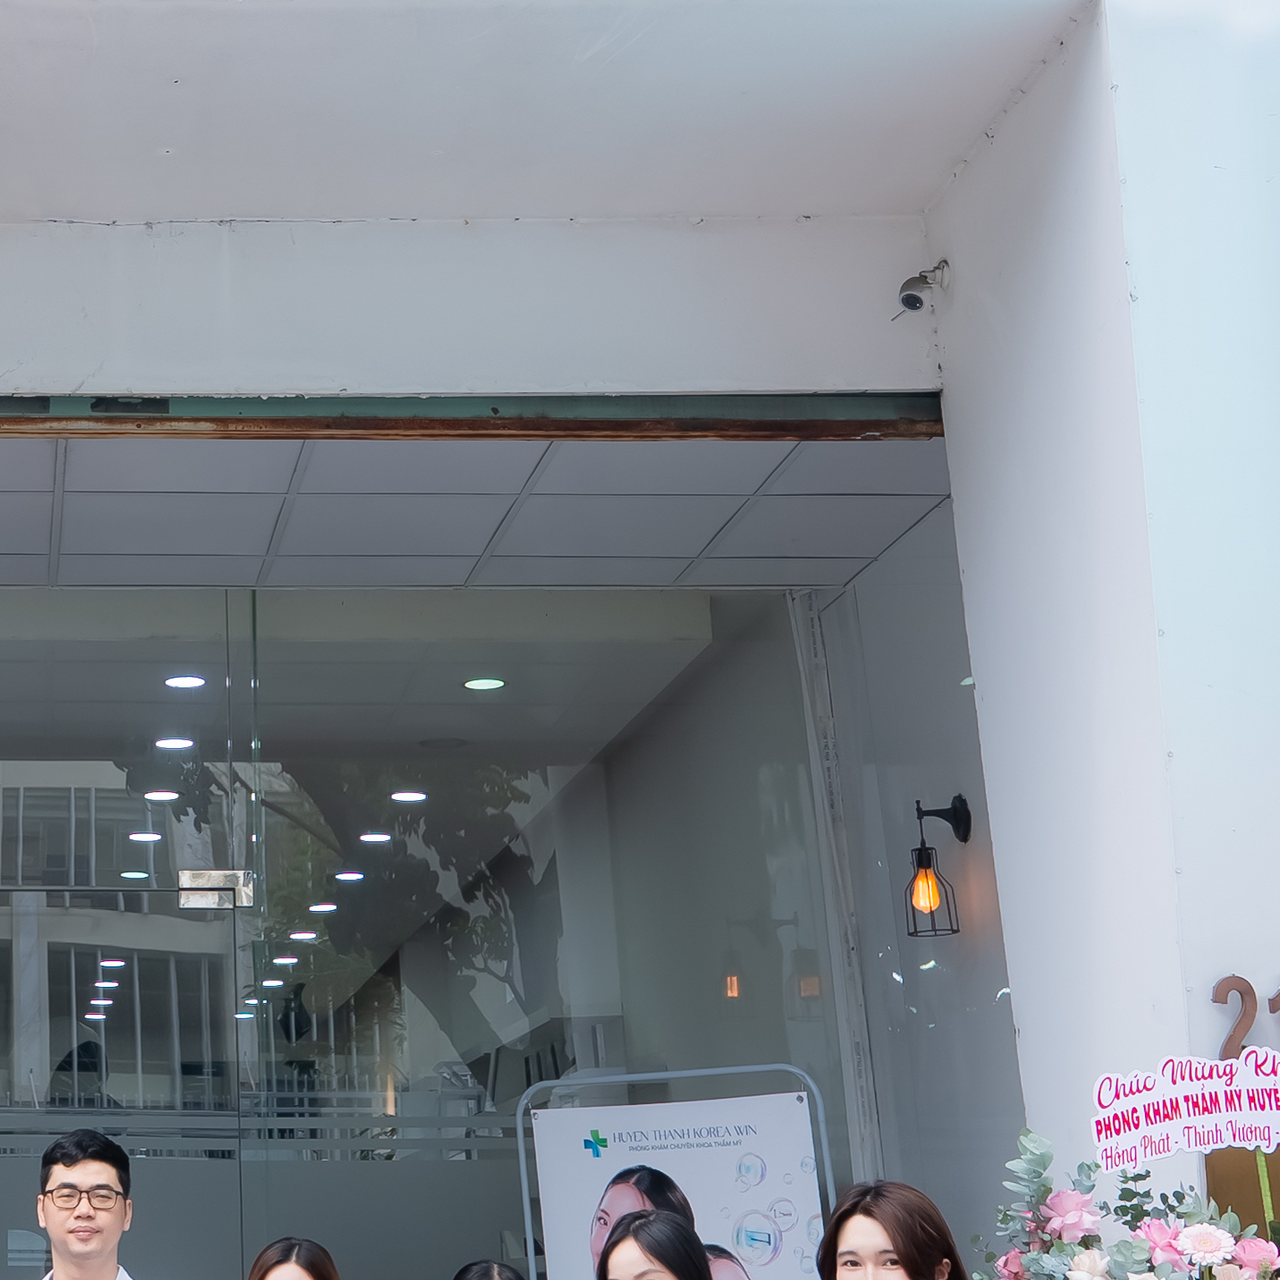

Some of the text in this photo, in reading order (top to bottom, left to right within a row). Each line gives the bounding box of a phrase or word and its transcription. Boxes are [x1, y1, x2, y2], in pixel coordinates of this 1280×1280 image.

[1096, 1074, 1157, 1110] Chúc
[1161, 1058, 1239, 1087] Mừng
[652, 1128, 691, 1142] THANH
[693, 1126, 732, 1140] KOREA
[734, 1124, 758, 1136] WIN
[1095, 1108, 1141, 1144] PHÒNG
[1143, 1093, 1182, 1127] KHÁM
[1101, 1140, 1138, 1172] Hồng
[1140, 1131, 1172, 1160] Phát
[1182, 1123, 1226, 1152] Thịnh
[1225, 1119, 1272, 1149] Vượng
